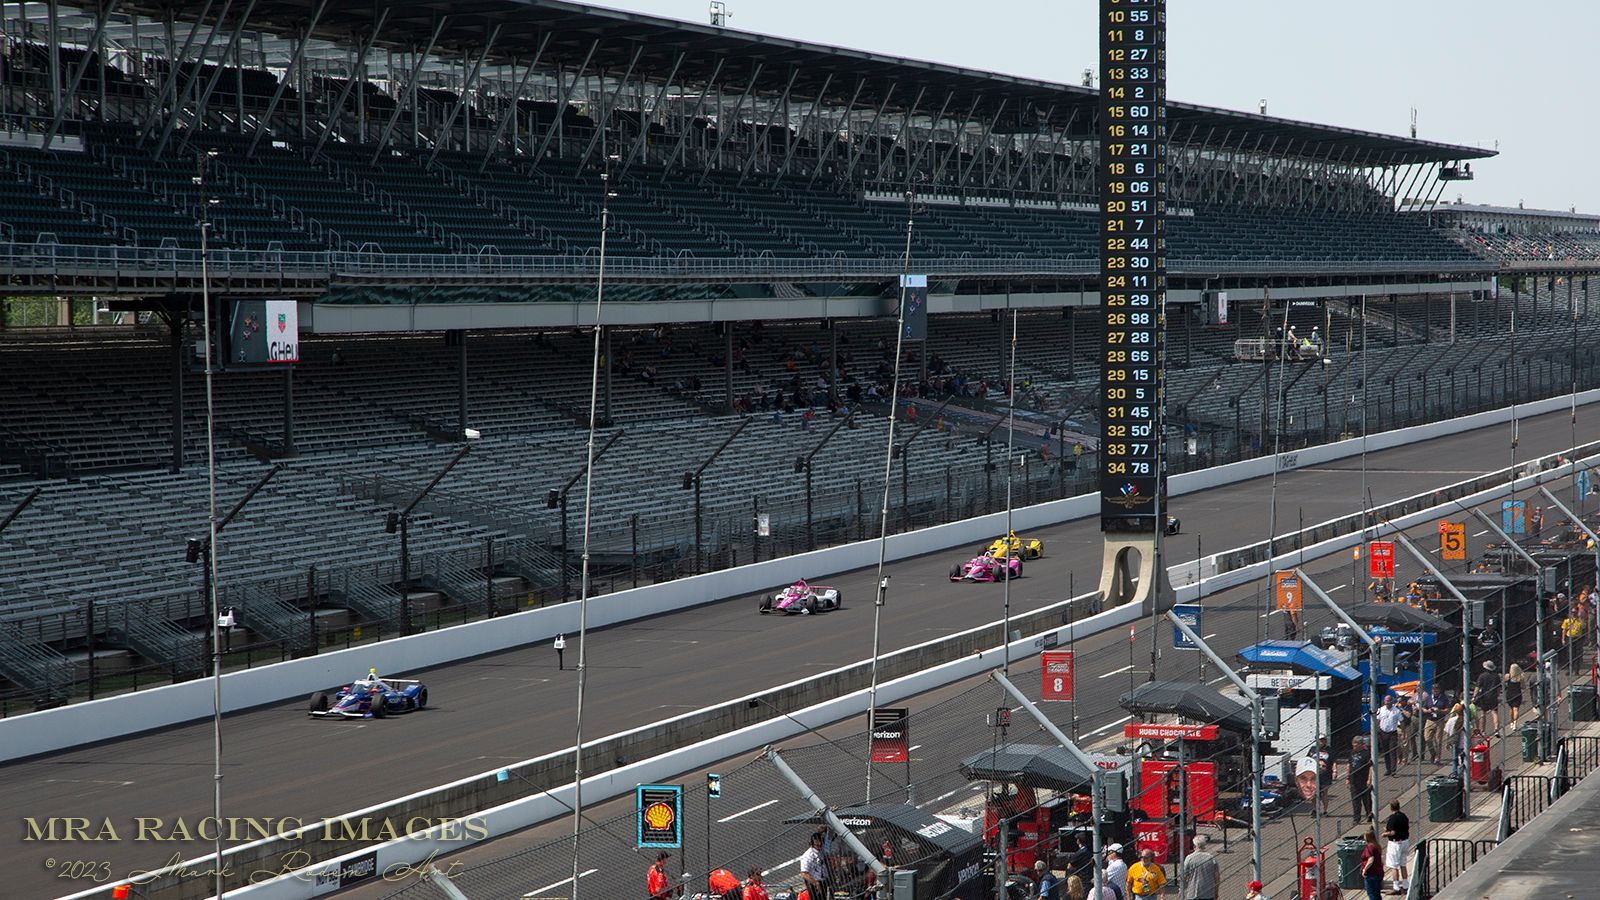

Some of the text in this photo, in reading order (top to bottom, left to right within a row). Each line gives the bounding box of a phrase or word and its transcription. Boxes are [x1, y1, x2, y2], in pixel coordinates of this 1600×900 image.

[1108, 10, 1149, 23] 10 55
[1108, 29, 1145, 42] 11 8
[1108, 48, 1148, 61] 12 27
[1108, 67, 1149, 80] 13 33
[1108, 86, 1145, 99] 14 2
[1108, 105, 1149, 118] 15 60
[1108, 124, 1149, 137] 16 14
[1108, 143, 1148, 156] 17 21
[1108, 162, 1145, 175] 18 6
[1108, 181, 1149, 194] 19 06
[1107, 200, 1147, 213] 20 51
[1107, 219, 1145, 232] 21 7
[1107, 238, 1149, 250] 22 44
[1107, 256, 1149, 269] 23 30
[1107, 275, 1148, 288] 24 11
[1107, 294, 1149, 306] 25 29
[1107, 313, 1149, 325] 26 98
[1107, 331, 1150, 344] 27 28
[1107, 350, 1150, 363] 28 66
[1107, 369, 1149, 381] 29 15
[1107, 388, 1145, 400] 30 5
[1107, 406, 1149, 418] 31 45
[1107, 425, 1150, 437] 32 50
[1107, 443, 1149, 455] 33 77
[1107, 462, 1149, 474] 34 78
[1507, 507, 1521, 525] 7
[1446, 531, 1461, 551] 5
[1286, 591, 1293, 604] 9
[1053, 677, 1063, 692] 8
